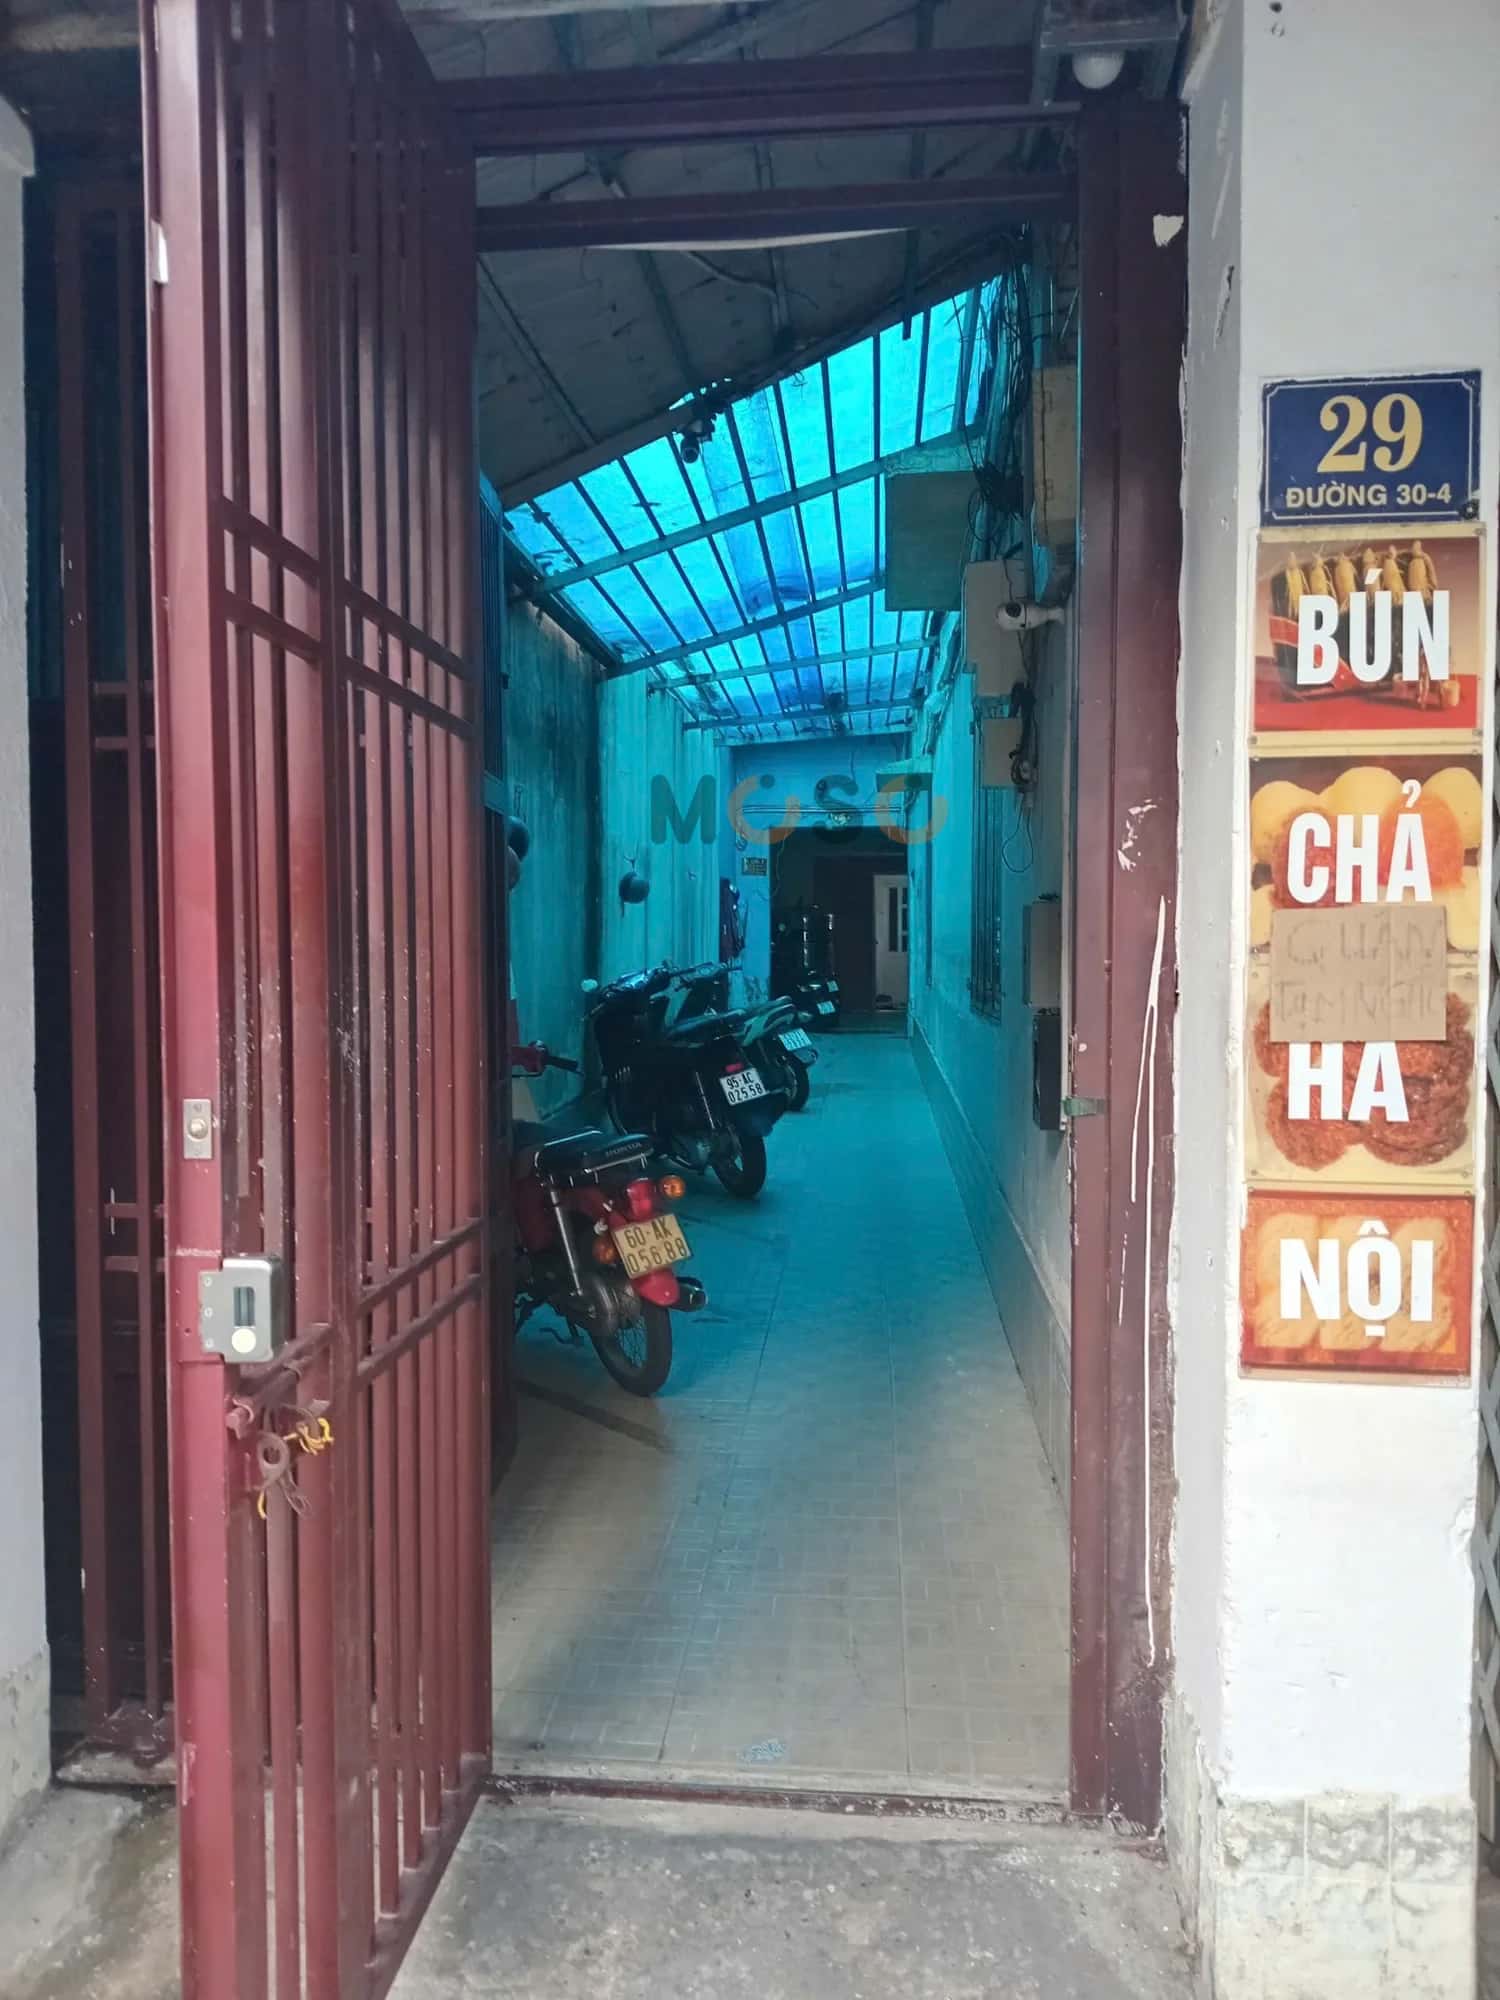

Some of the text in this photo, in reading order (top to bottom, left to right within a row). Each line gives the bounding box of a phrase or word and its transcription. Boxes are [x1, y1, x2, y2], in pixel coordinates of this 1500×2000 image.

[1317, 393, 1423, 473] 29
[1286, 480, 1451, 508] ĐƯỜNG 30-4
[1297, 568, 1449, 685] BÚN
[1287, 779, 1433, 903] CHẢ
[1280, 1218, 1434, 1337] NỘI
